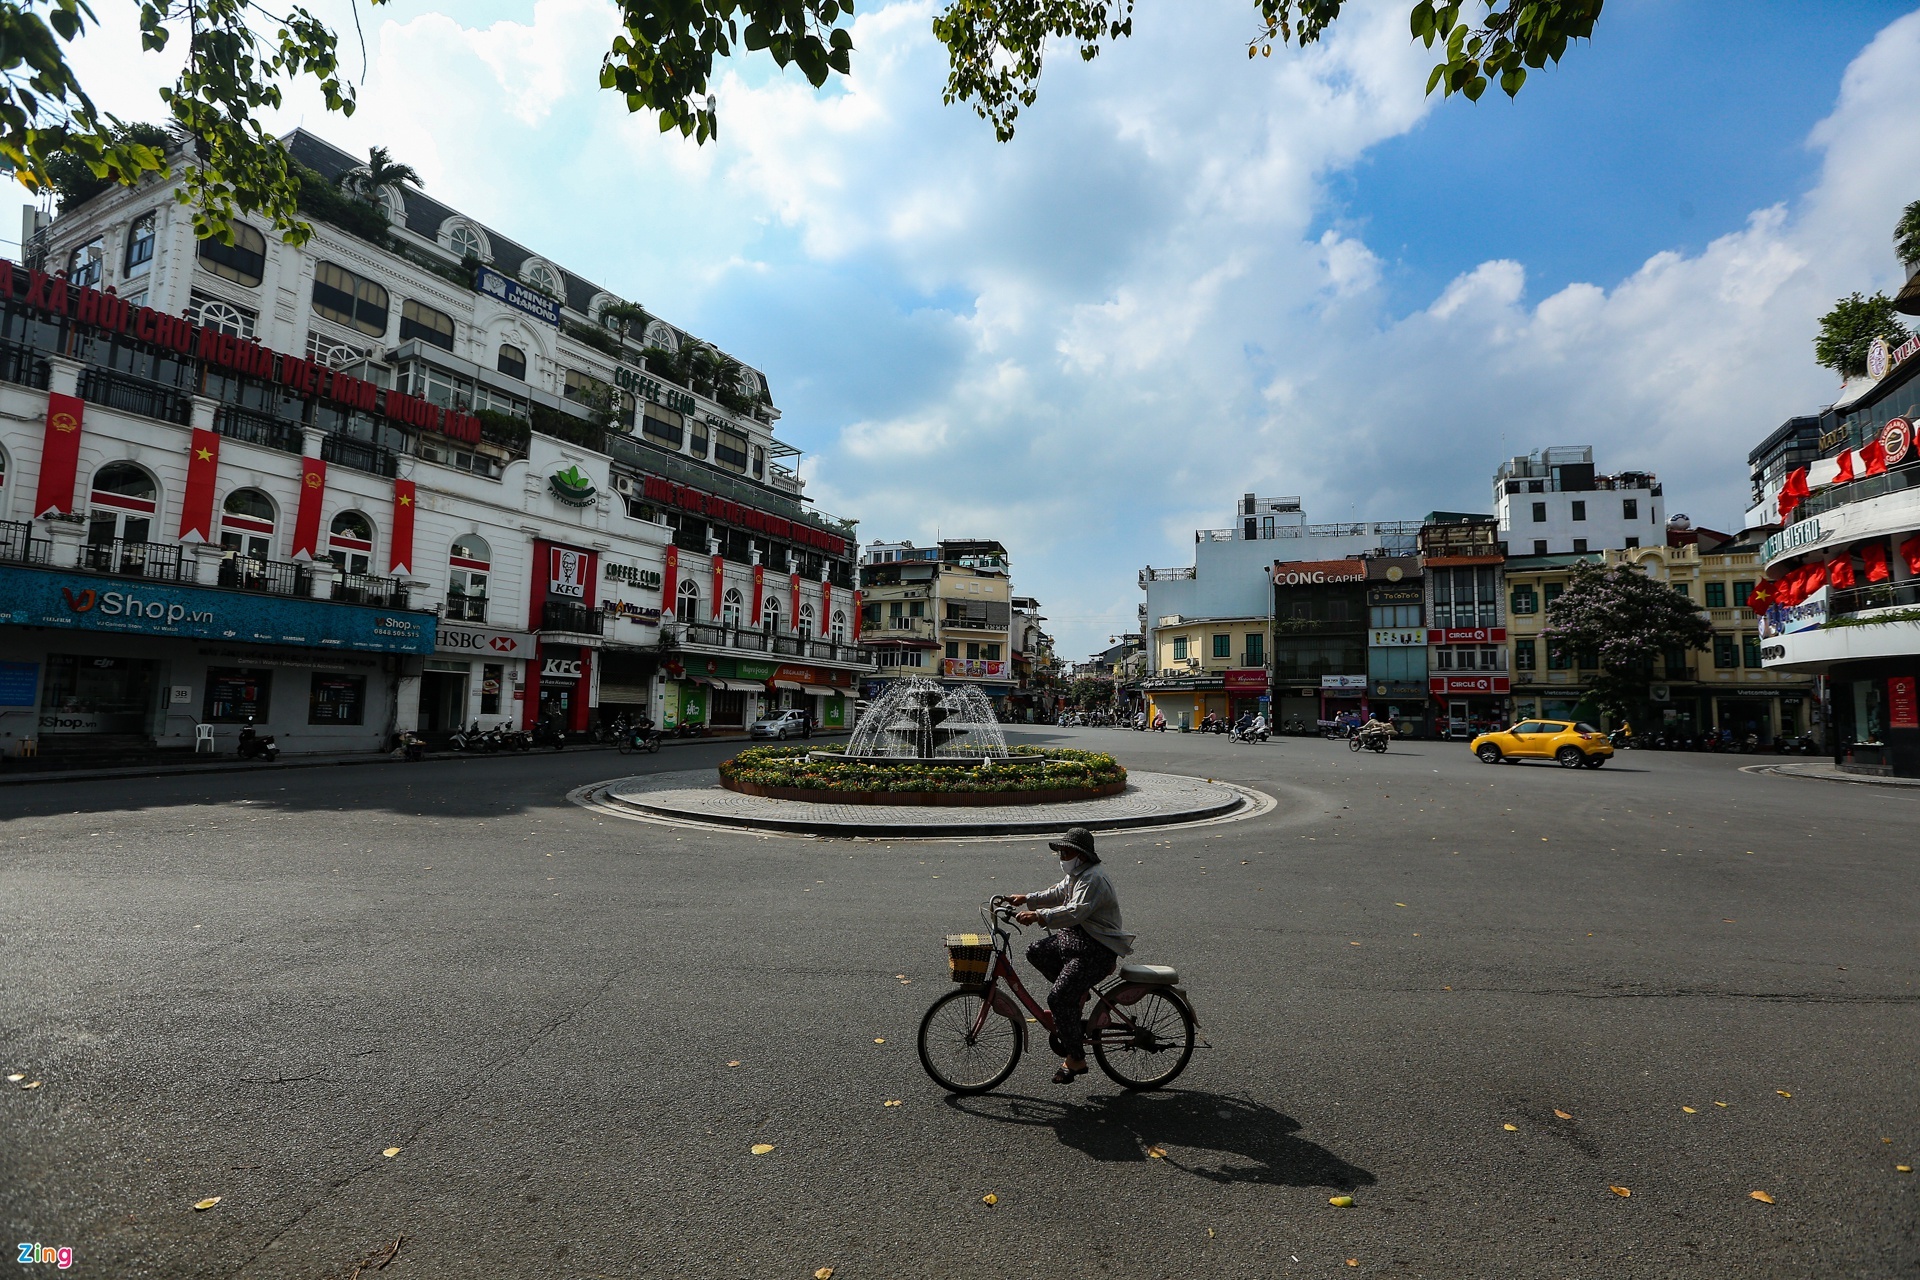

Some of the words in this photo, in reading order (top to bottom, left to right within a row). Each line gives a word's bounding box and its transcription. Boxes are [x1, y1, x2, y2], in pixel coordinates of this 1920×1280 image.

[508, 292, 557, 324] DIAMOND
[514, 285, 554, 312] MINH
[78, 285, 129, 341] HỘI
[136, 306, 193, 354] CHỦ
[199, 325, 274, 381] NGHĨA
[281, 352, 330, 399] VIỆT
[330, 370, 378, 413] NAM
[614, 366, 662, 403] COFFEE
[667, 389, 696, 416] CLUB
[547, 486, 597, 508] PHYTOPHARCO
[1783, 518, 1818, 551] BISTRO
[606, 563, 638, 581] COFFEE
[640, 569, 660, 585] CLUB
[1274, 569, 1325, 588] CỘNG
[555, 583, 580, 596] KFC
[435, 629, 486, 650] HSBC
[543, 658, 582, 674] KFC
